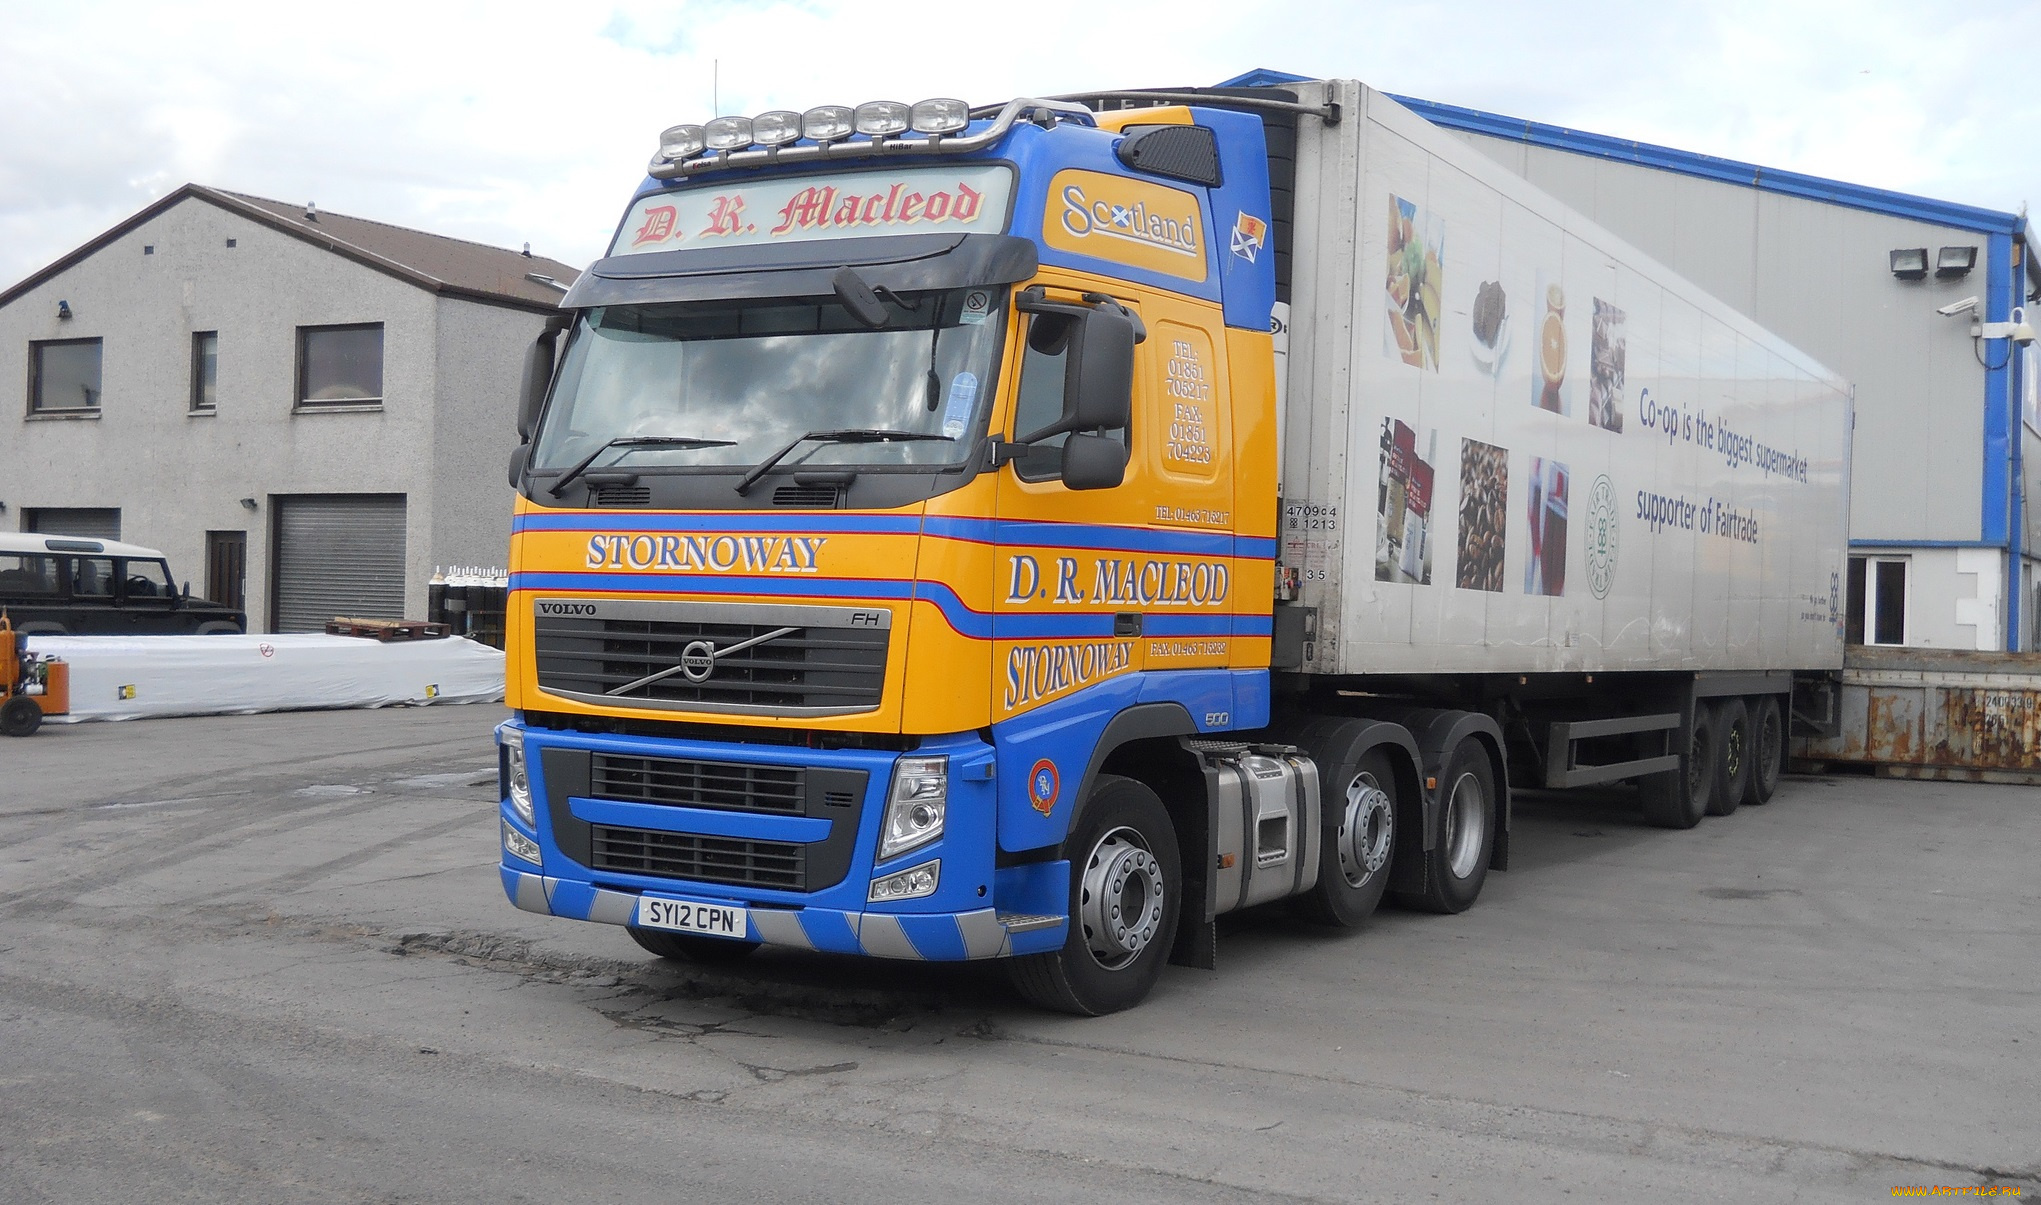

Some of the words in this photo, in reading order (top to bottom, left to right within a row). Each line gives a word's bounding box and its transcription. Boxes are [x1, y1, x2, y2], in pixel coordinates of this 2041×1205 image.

[632, 205, 685, 248] D.
[700, 195, 757, 239] R.
[769, 182, 985, 236] Macleod
[1061, 185, 1197, 250] Scotland
[1173, 340, 1199, 361] TEL:
[1167, 359, 1204, 382] 01851
[1165, 378, 1209, 401] 705217
[1174, 403, 1203, 424] FAX:
[1169, 422, 1206, 444] 01851
[1639, 387, 1678, 445] Co-op
[1683, 403, 1692, 442] is
[1696, 409, 1713, 450] the
[1717, 416, 1753, 468] biggest
[1756, 442, 1808, 485] supermarket
[1167, 441, 1211, 464] 704223
[1155, 506, 1173, 520] TEL:
[1304, 519, 1336, 530] 1213
[1637, 489, 1697, 534] supporter
[1700, 497, 1713, 534] of
[1715, 502, 1758, 545] Fairtrade
[586, 534, 828, 573] STORNOWAY
[1005, 555, 1046, 604] D.
[1053, 557, 1085, 604] R.
[1090, 559, 1229, 606] MACLEOD
[539, 603, 597, 616] VOLVO
[851, 612, 880, 626] FH
[682, 658, 713, 666] VOLVO
[1004, 641, 1135, 710] STORNOWAY
[1205, 711, 1229, 727] 500
[650, 901, 691, 927] SY12
[696, 907, 734, 933] CPN
